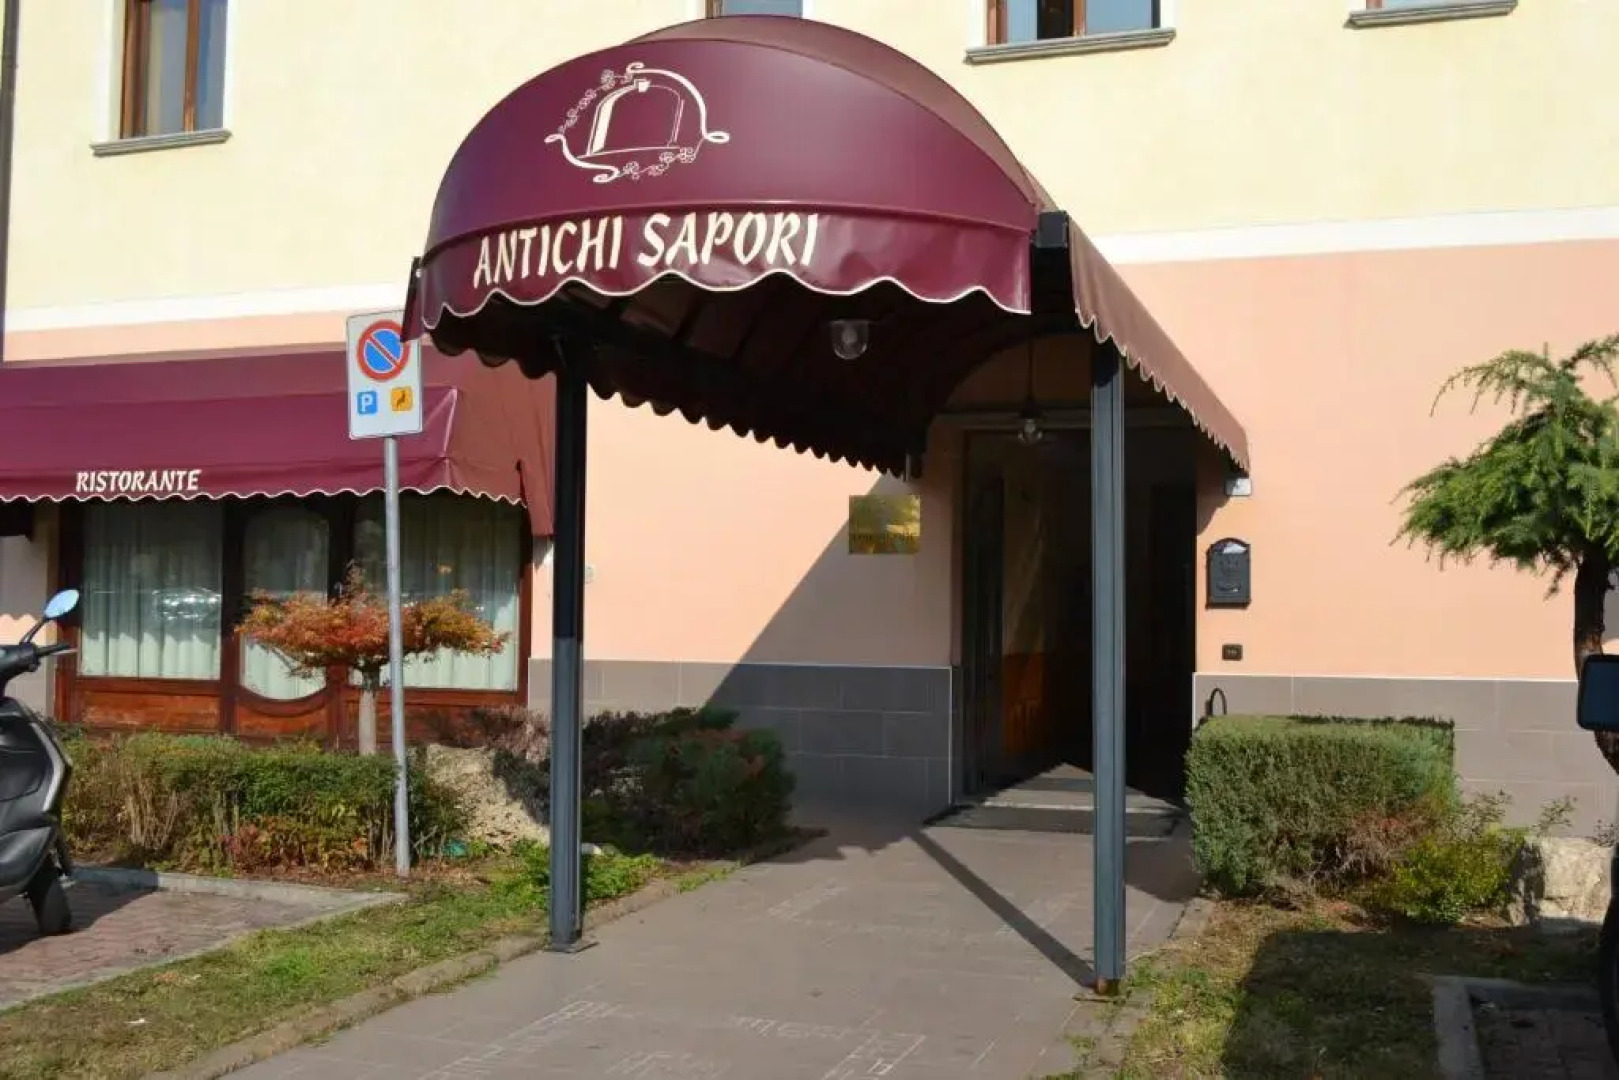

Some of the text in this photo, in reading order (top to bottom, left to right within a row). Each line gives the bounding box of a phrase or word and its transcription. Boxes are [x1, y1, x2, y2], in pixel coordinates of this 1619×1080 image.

[473, 212, 819, 288] ANTICHI SAPORI
[361, 393, 374, 412] P
[76, 469, 202, 492] RISTORANTE
